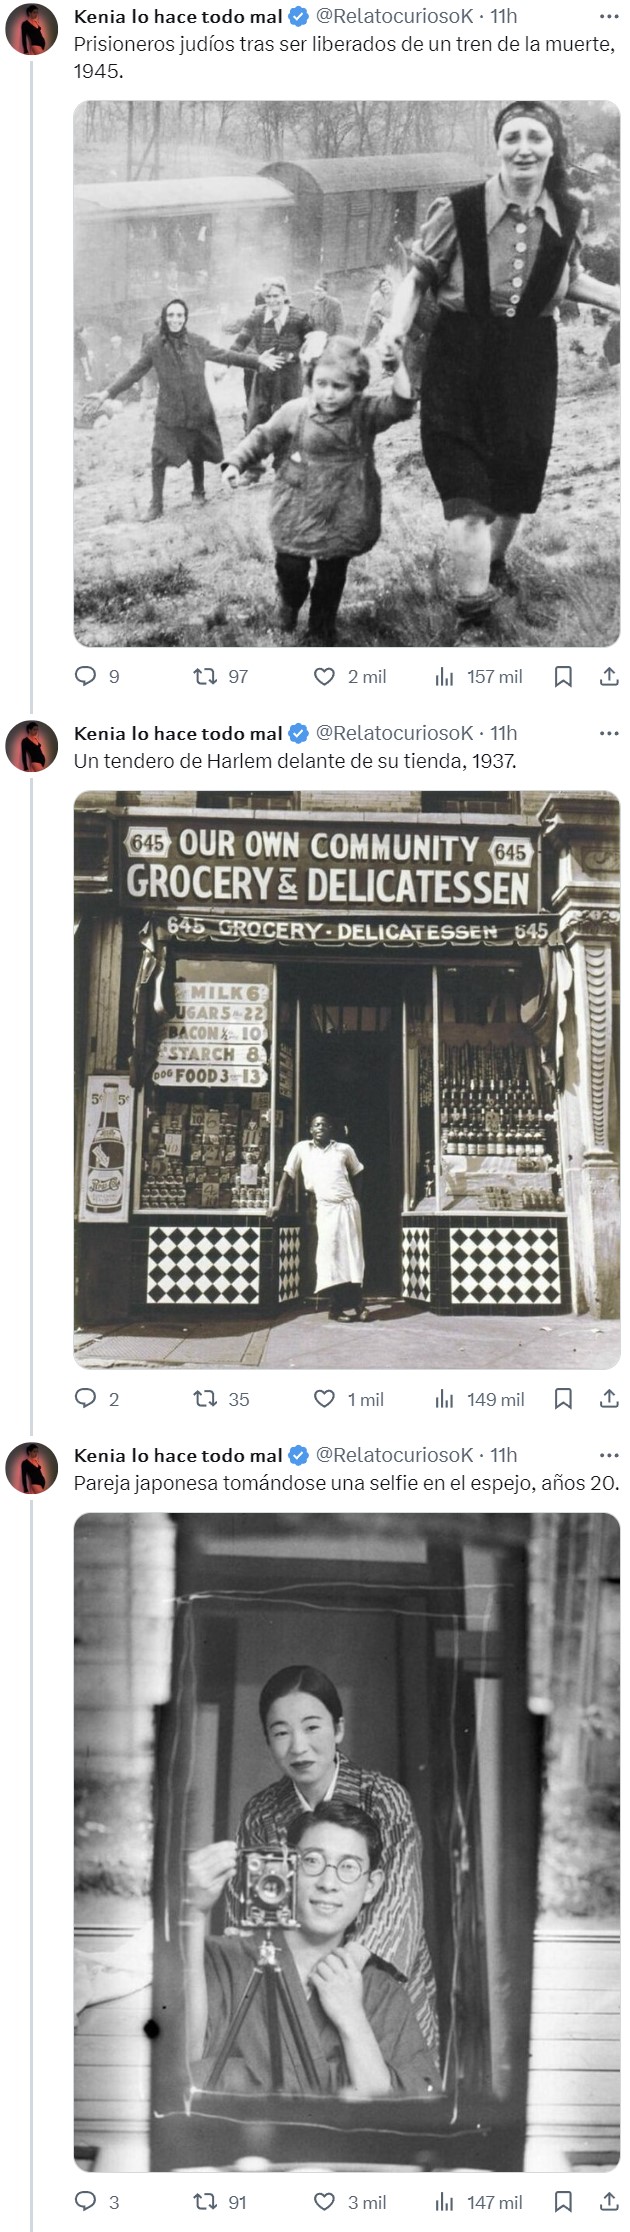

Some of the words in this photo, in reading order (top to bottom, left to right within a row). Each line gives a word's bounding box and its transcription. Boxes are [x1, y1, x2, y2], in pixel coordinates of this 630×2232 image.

[132, 834, 164, 851] 645
[179, 828, 235, 857] OUR
[245, 830, 299, 858] OWN
[311, 832, 480, 862] COMMUNITY
[494, 843, 527, 861] 645
[126, 863, 274, 900] GROCERY
[277, 867, 298, 900] &
[308, 867, 530, 906] DELICATESSEN
[167, 916, 206, 934] 645
[218, 919, 323, 940] GROCERY
[338, 922, 498, 940] DELICATESSEN
[514, 922, 549, 940] 645
[191, 985, 243, 1000] MILK
[246, 985, 260, 1001] 6
[175, 1005, 219, 1020] UGAR
[220, 1006, 231, 1020] 5
[244, 1006, 263, 1021] 22
[168, 1026, 219, 1040] BACON
[242, 1026, 261, 1041] 10
[168, 1047, 235, 1061] STARCH
[246, 1046, 260, 1062] 8
[153, 1068, 173, 1081] DOG
[175, 1068, 218, 1083] FOOD
[219, 1069, 229, 1083] 3
[242, 1069, 261, 1083] 13
